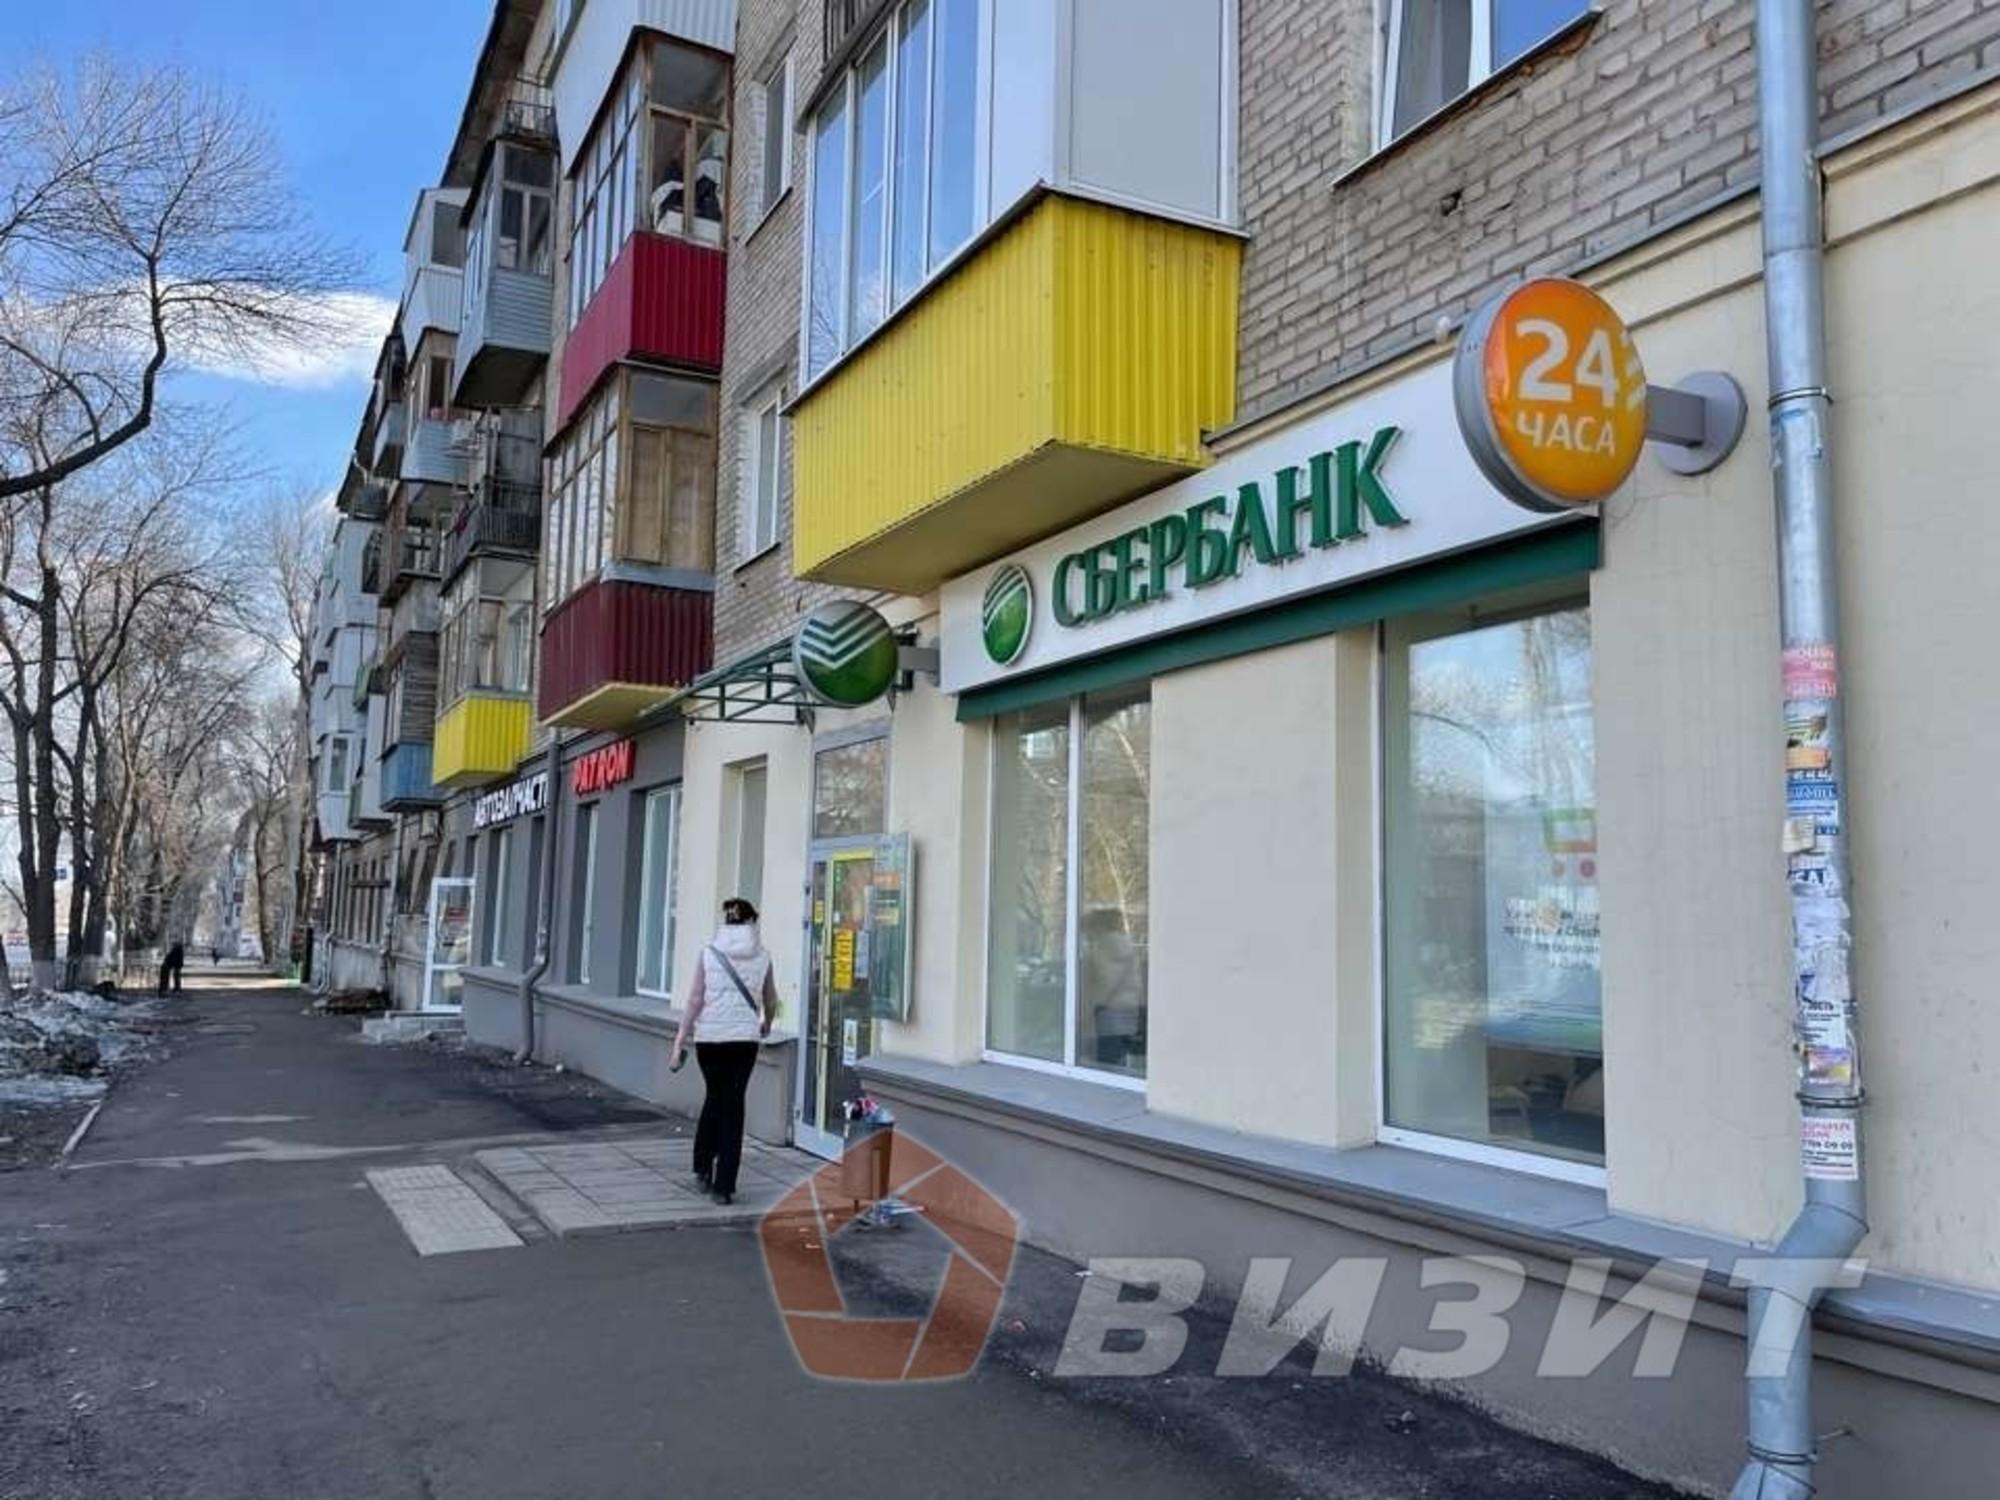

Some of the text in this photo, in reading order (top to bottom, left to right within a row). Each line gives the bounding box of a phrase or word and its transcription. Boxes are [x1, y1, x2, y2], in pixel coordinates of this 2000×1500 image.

[1515, 317, 1619, 409] 24
[1515, 410, 1617, 458] ЧАСА
[1052, 426, 1411, 628] СБЕРБАНК
[573, 738, 635, 795] PATRON
